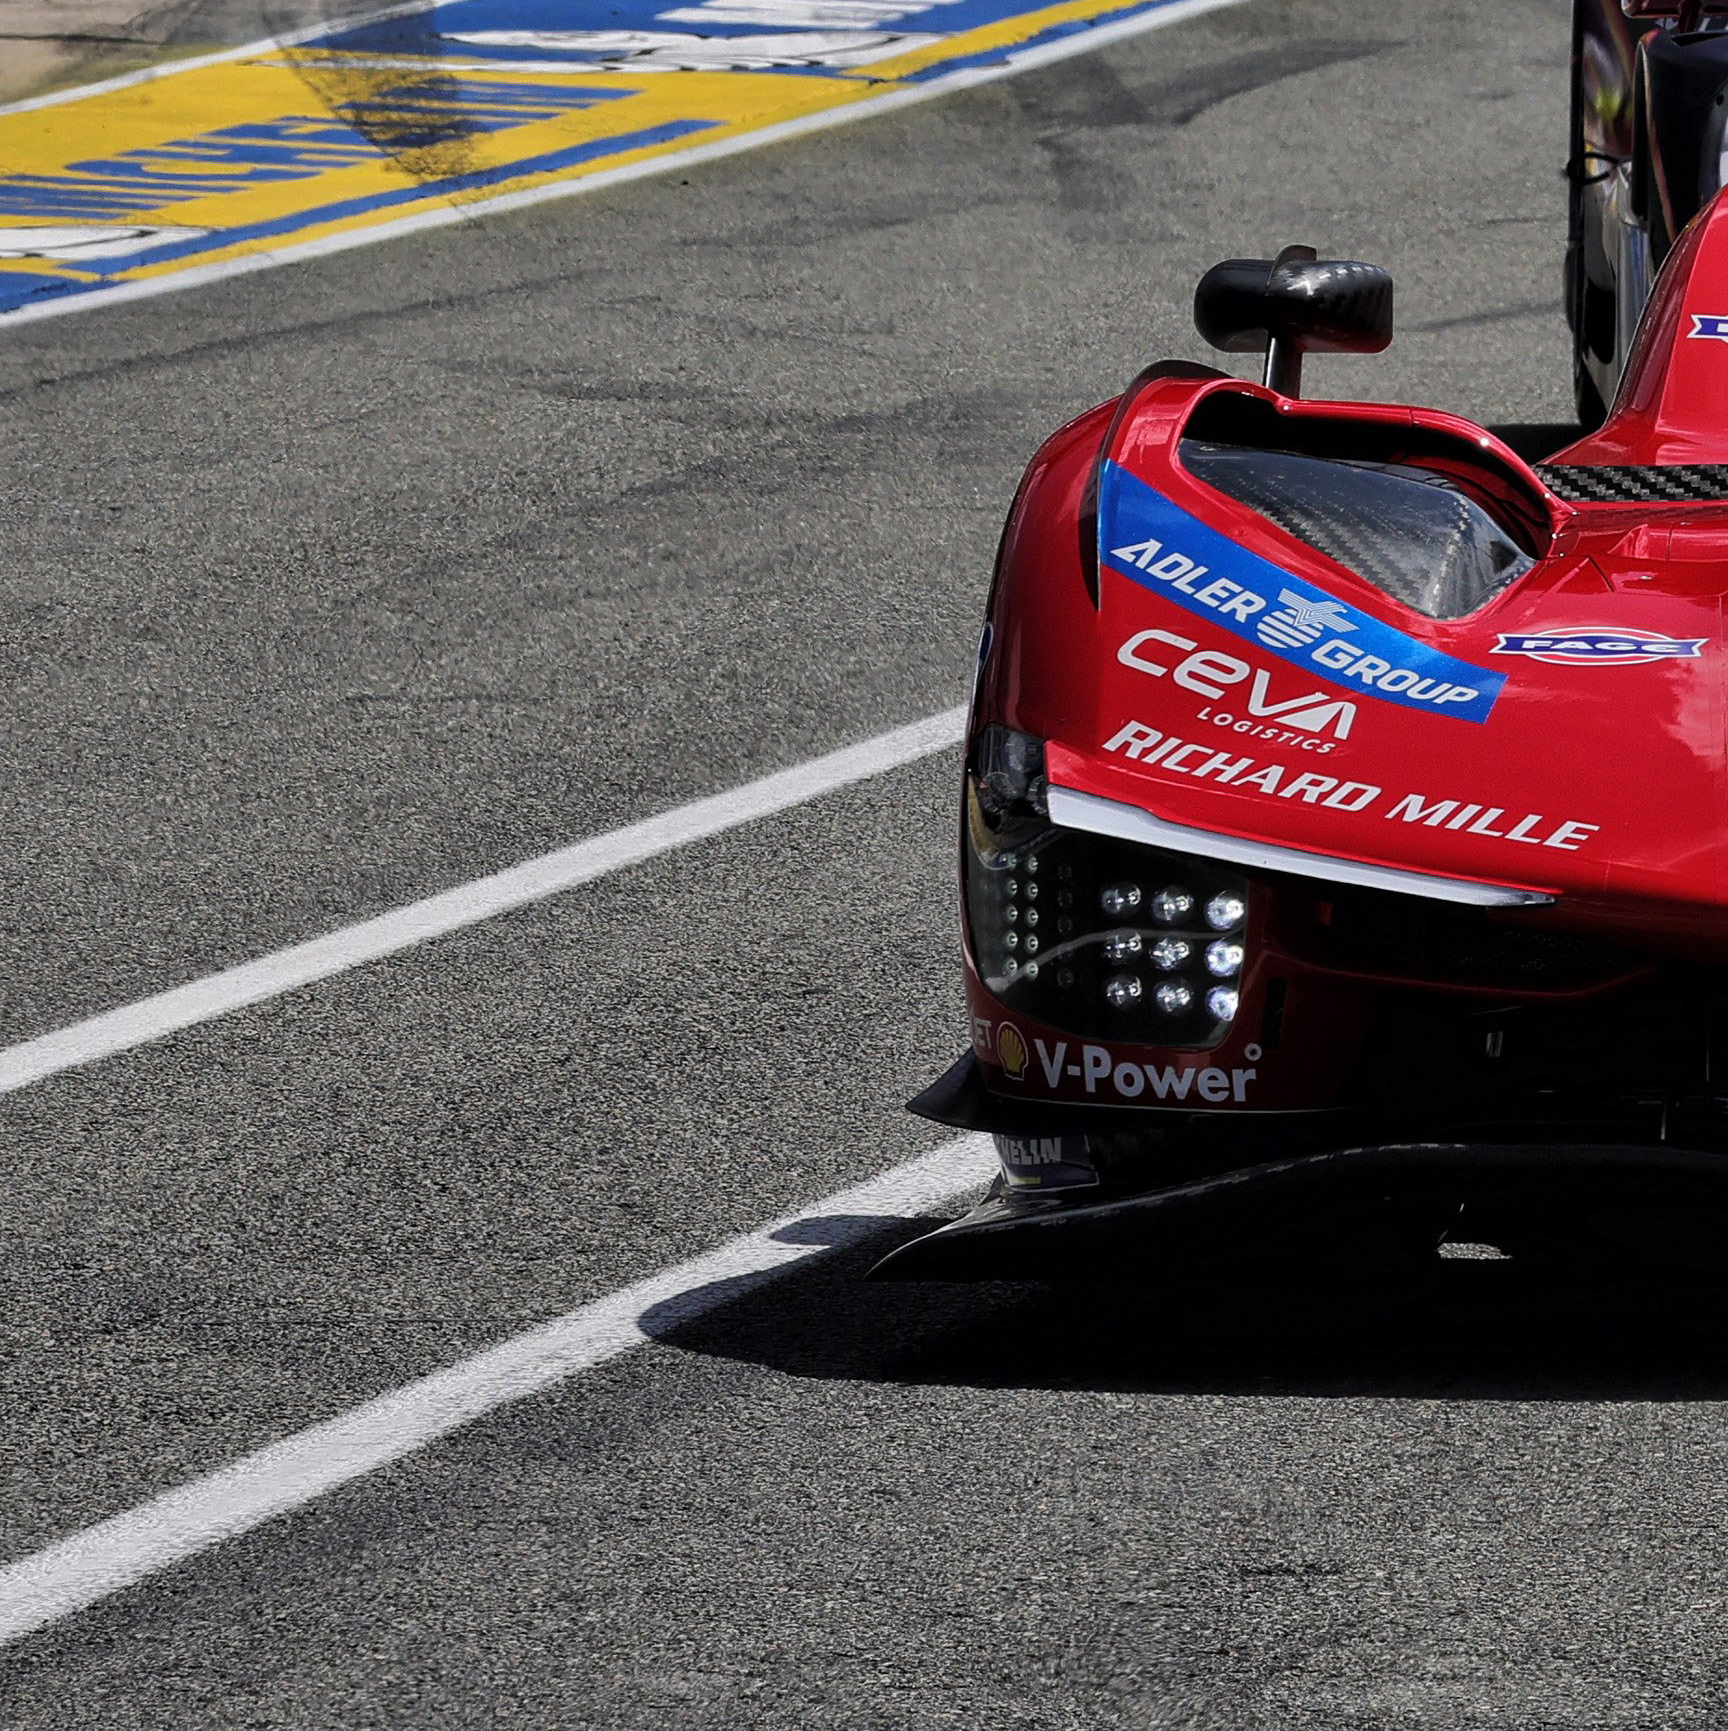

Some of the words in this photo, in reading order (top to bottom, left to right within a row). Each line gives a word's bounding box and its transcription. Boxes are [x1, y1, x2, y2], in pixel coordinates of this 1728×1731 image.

[1111, 538, 1268, 624] ADLER
[1311, 638, 1481, 706] GROUP
[1521, 636, 1682, 656] FAGE
[1196, 706, 1338, 757] LOGISTICS
[1101, 719, 1384, 816] RICHARD
[1385, 793, 1602, 854] MILLE
[1034, 1038, 1257, 1103] V-Power
